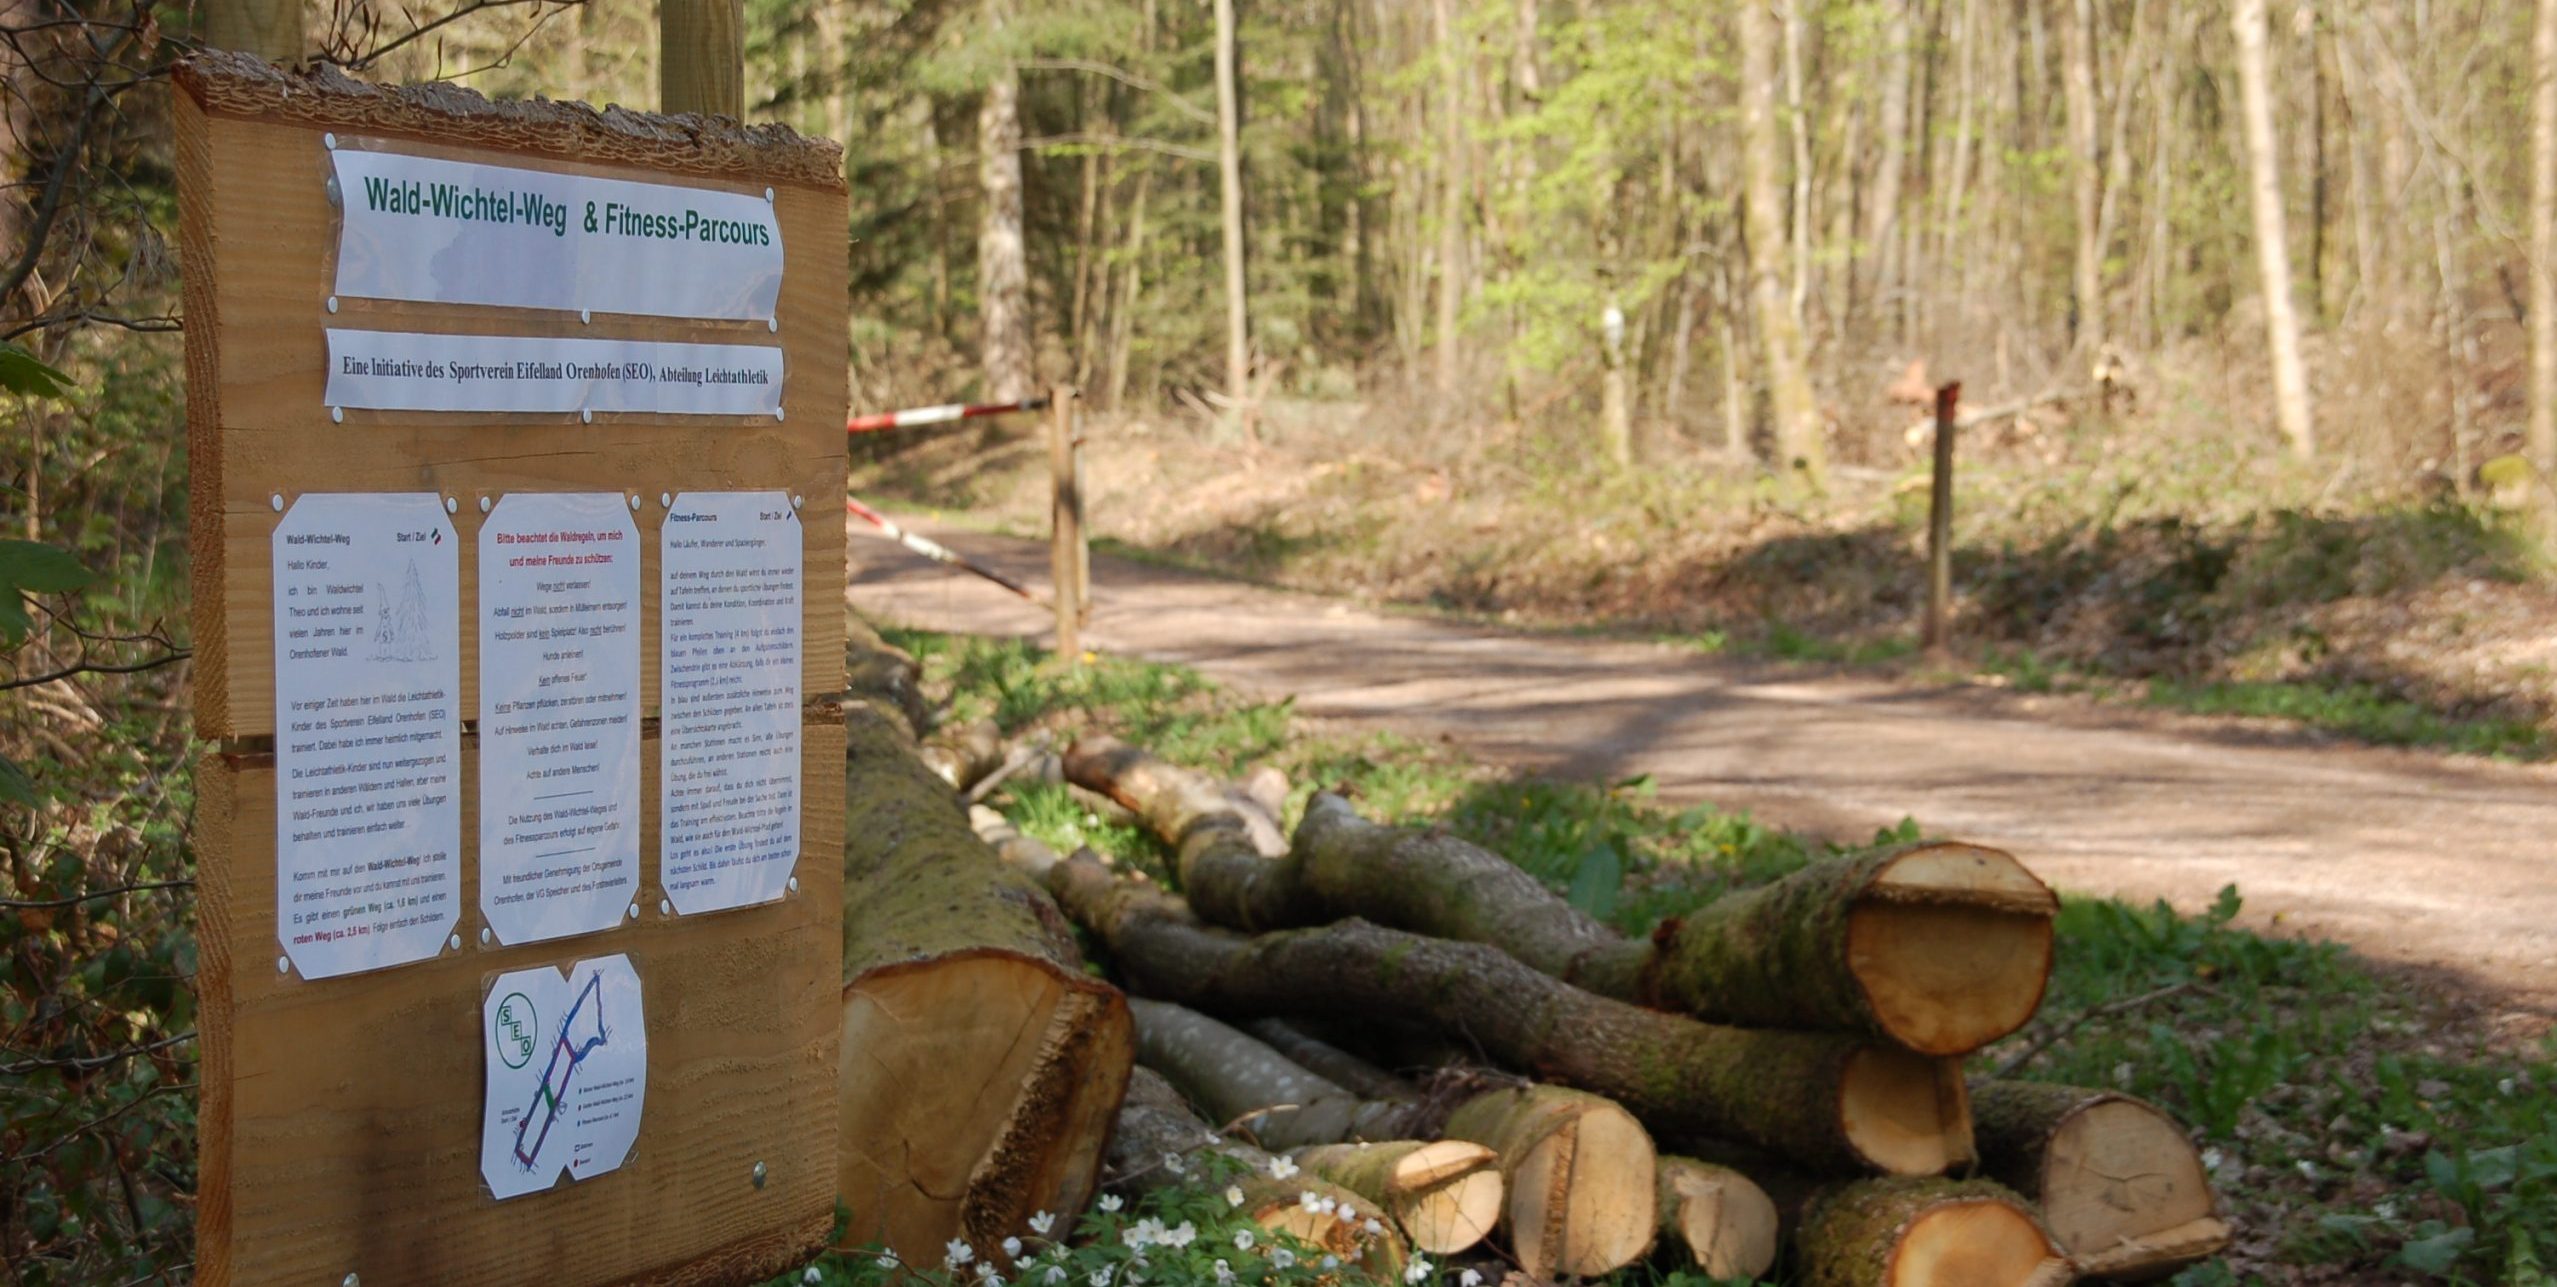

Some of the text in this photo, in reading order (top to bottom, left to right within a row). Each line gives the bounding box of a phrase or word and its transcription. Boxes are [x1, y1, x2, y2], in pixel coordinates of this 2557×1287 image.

[365, 177, 770, 247] Wald-Wichtel-Weg & Fitness-Parcours
[343, 356, 769, 387] Eine Initiative des Sportverein Eifelland Orenhofen (SEO), Abteilung Leichtathletik
[670, 513, 717, 521] Fitness-Parcours
[287, 534, 351, 546] Wald-Wichtel-Weg
[397, 532, 410, 542] Start
[416, 532, 426, 541] Ziel
[497, 533, 514, 543] Bitte
[516, 532, 547, 543] beachtet
[549, 532, 558, 542] die
[608, 530, 622, 540] mich
[510, 557, 523, 567] und
[525, 556, 546, 566] meine
[548, 555, 573, 565] Freunde
[575, 556, 582, 564] zu
